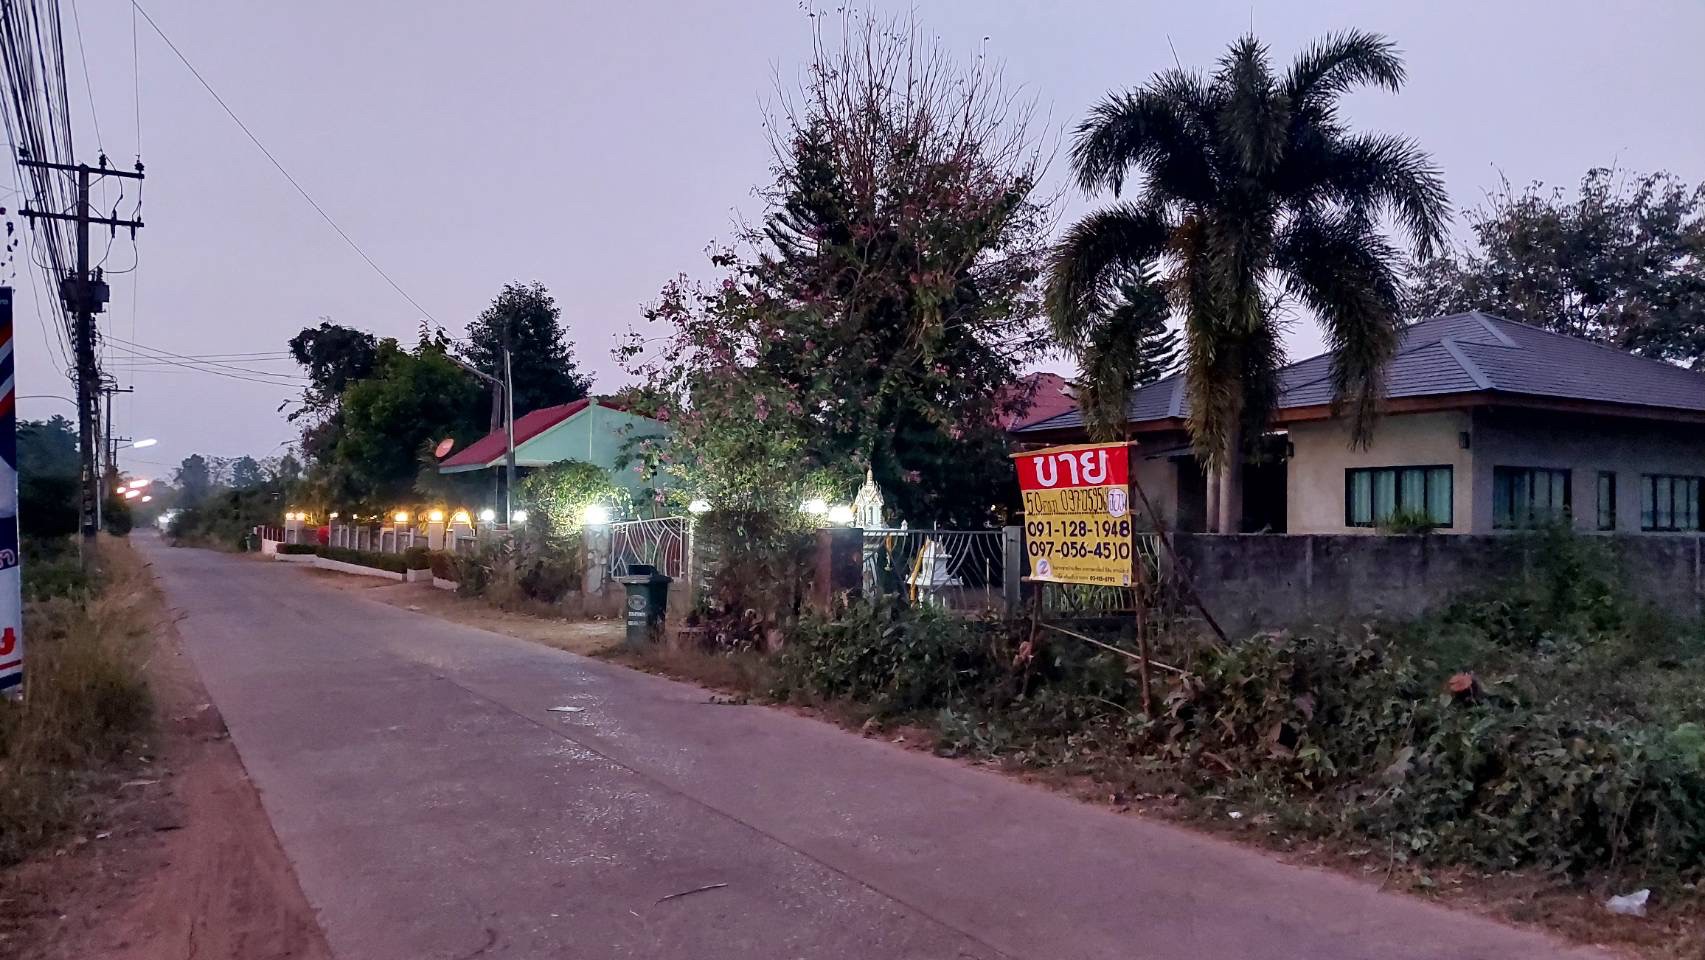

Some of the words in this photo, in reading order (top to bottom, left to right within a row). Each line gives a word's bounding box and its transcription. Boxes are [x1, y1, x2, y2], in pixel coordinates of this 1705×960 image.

[1033, 450, 1107, 487] ขาย
[1027, 520, 1131, 538] 091-128-1948
[1029, 541, 1130, 562] 097-056-4510
